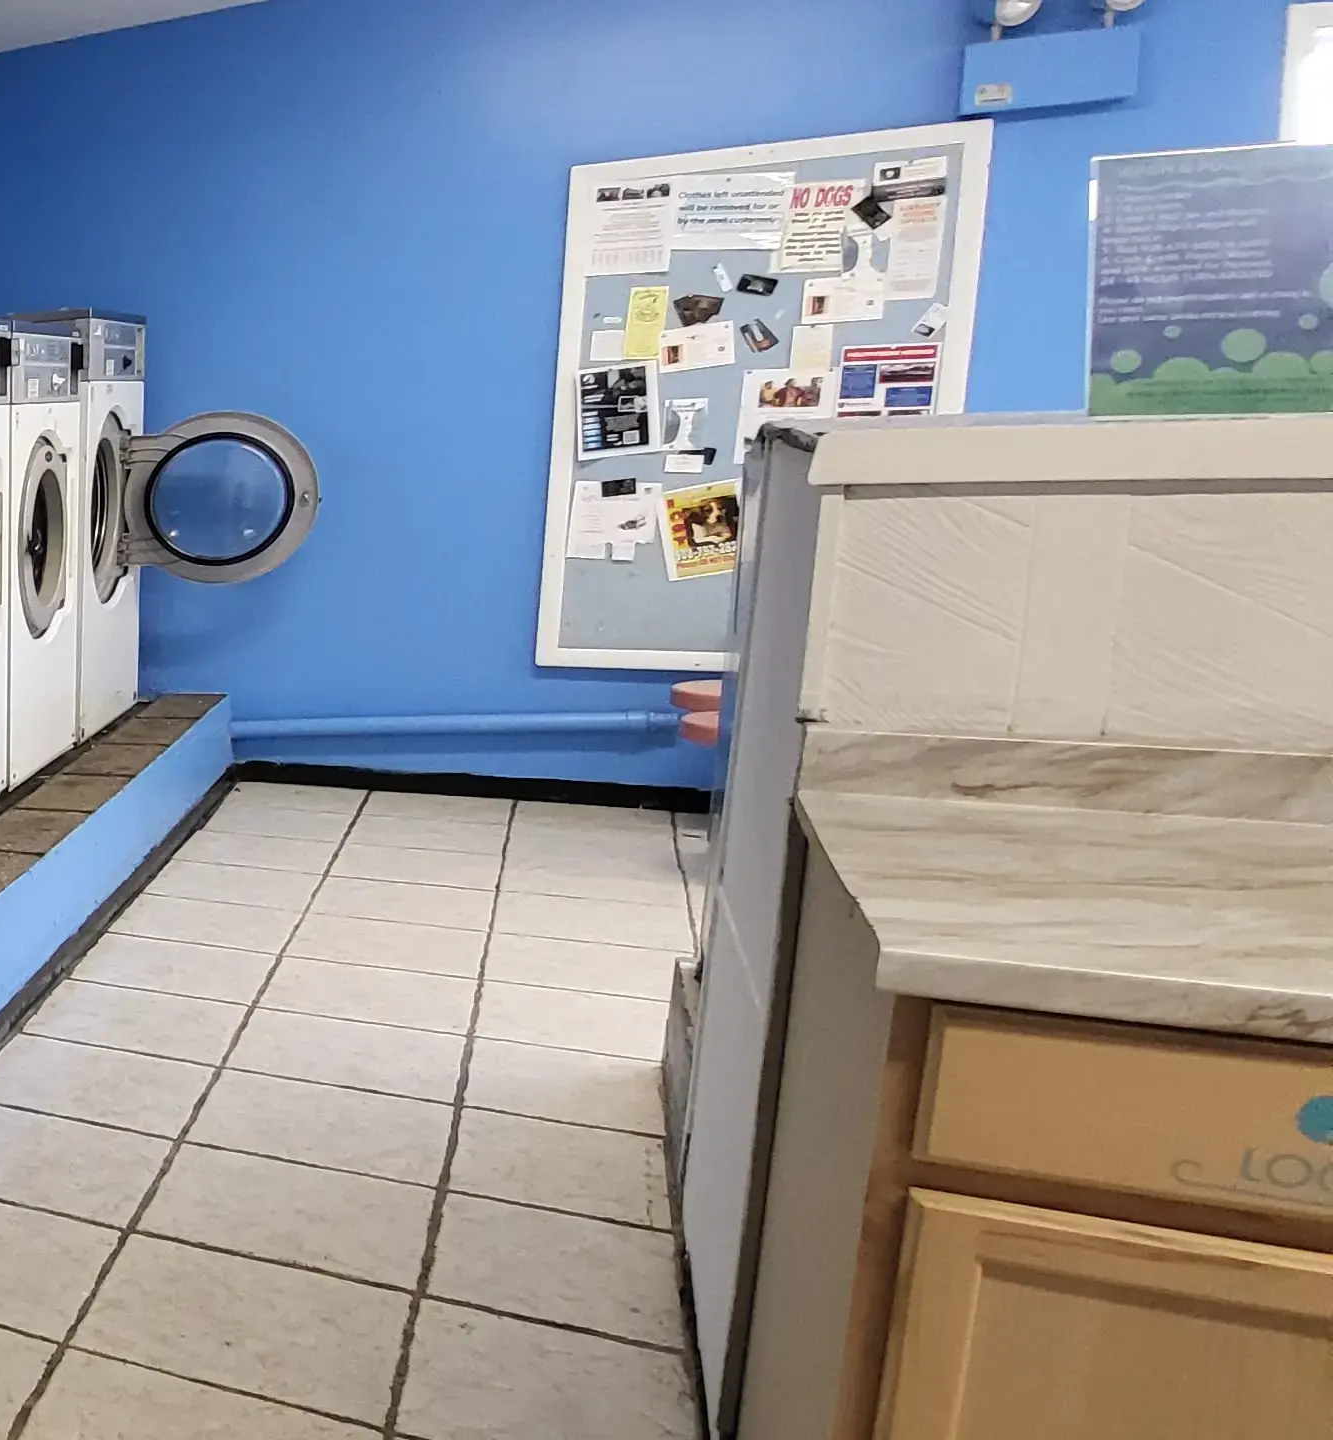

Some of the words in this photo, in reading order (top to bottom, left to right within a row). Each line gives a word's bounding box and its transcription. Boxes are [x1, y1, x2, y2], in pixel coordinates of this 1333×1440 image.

[789, 187, 810, 209] NO
[815, 185, 853, 207] DOGS
[1239, 1147, 1333, 1192] LO
